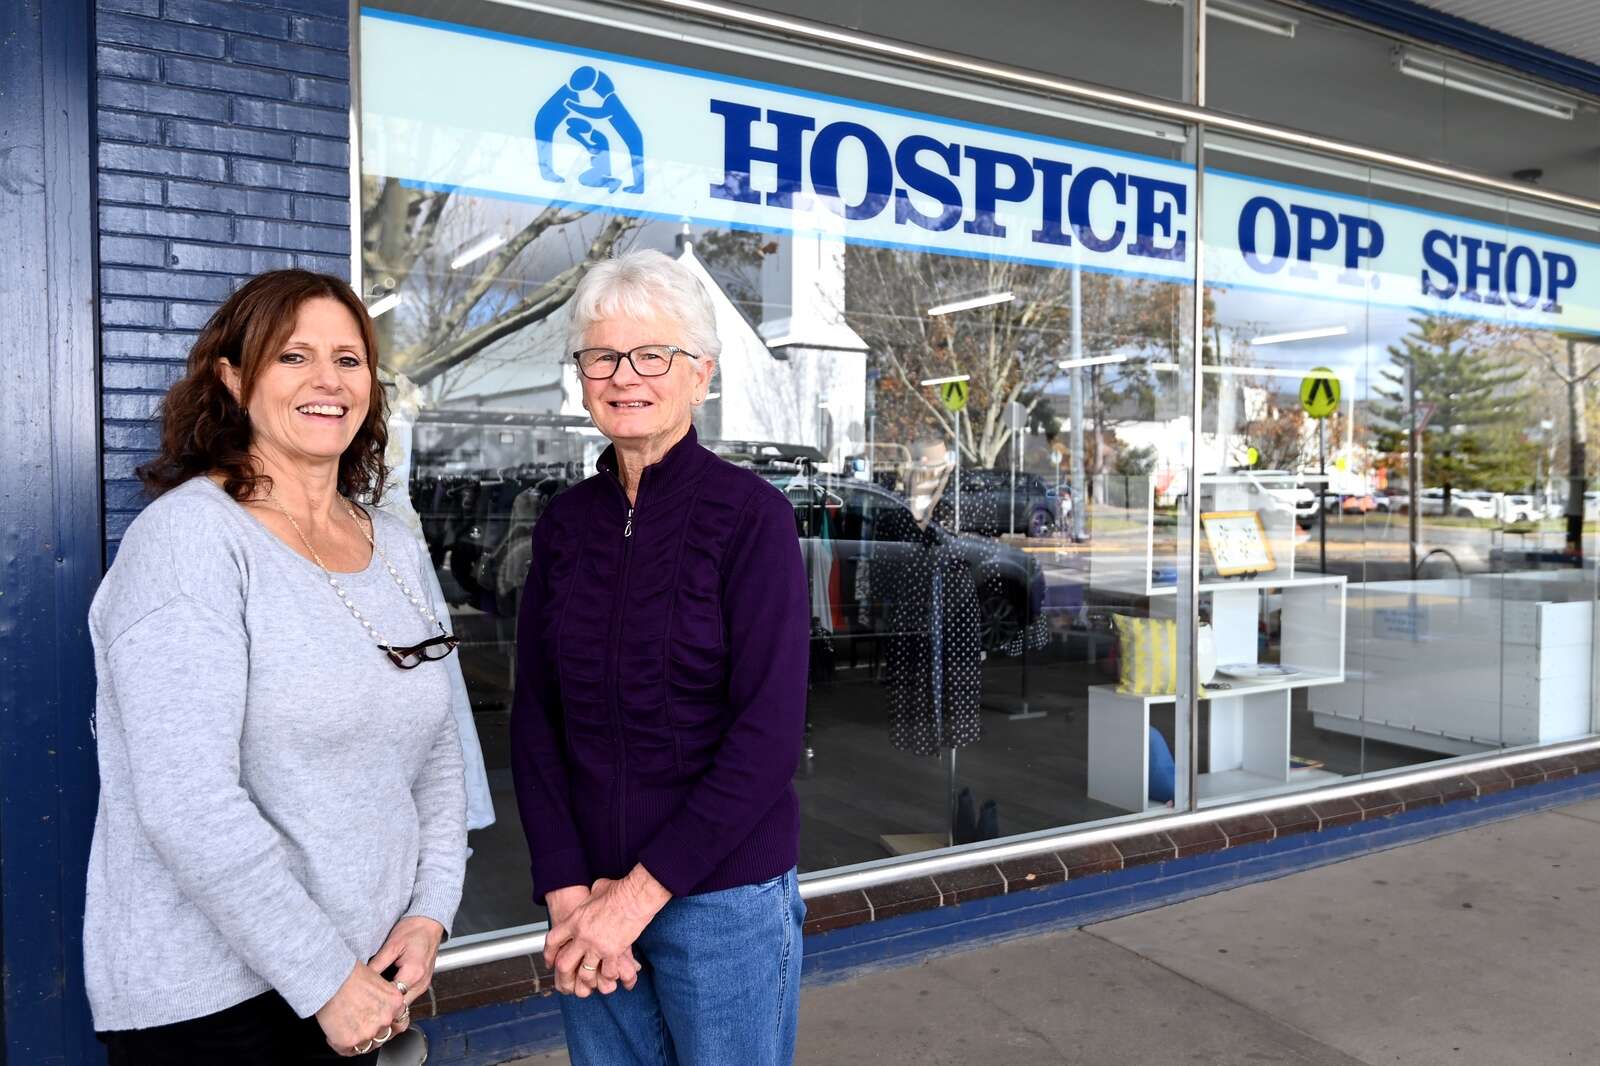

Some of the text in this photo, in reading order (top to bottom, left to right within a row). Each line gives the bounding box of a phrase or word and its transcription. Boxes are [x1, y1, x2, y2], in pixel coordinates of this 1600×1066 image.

[710, 98, 1577, 314] HOSPICE OPP. SHOP
